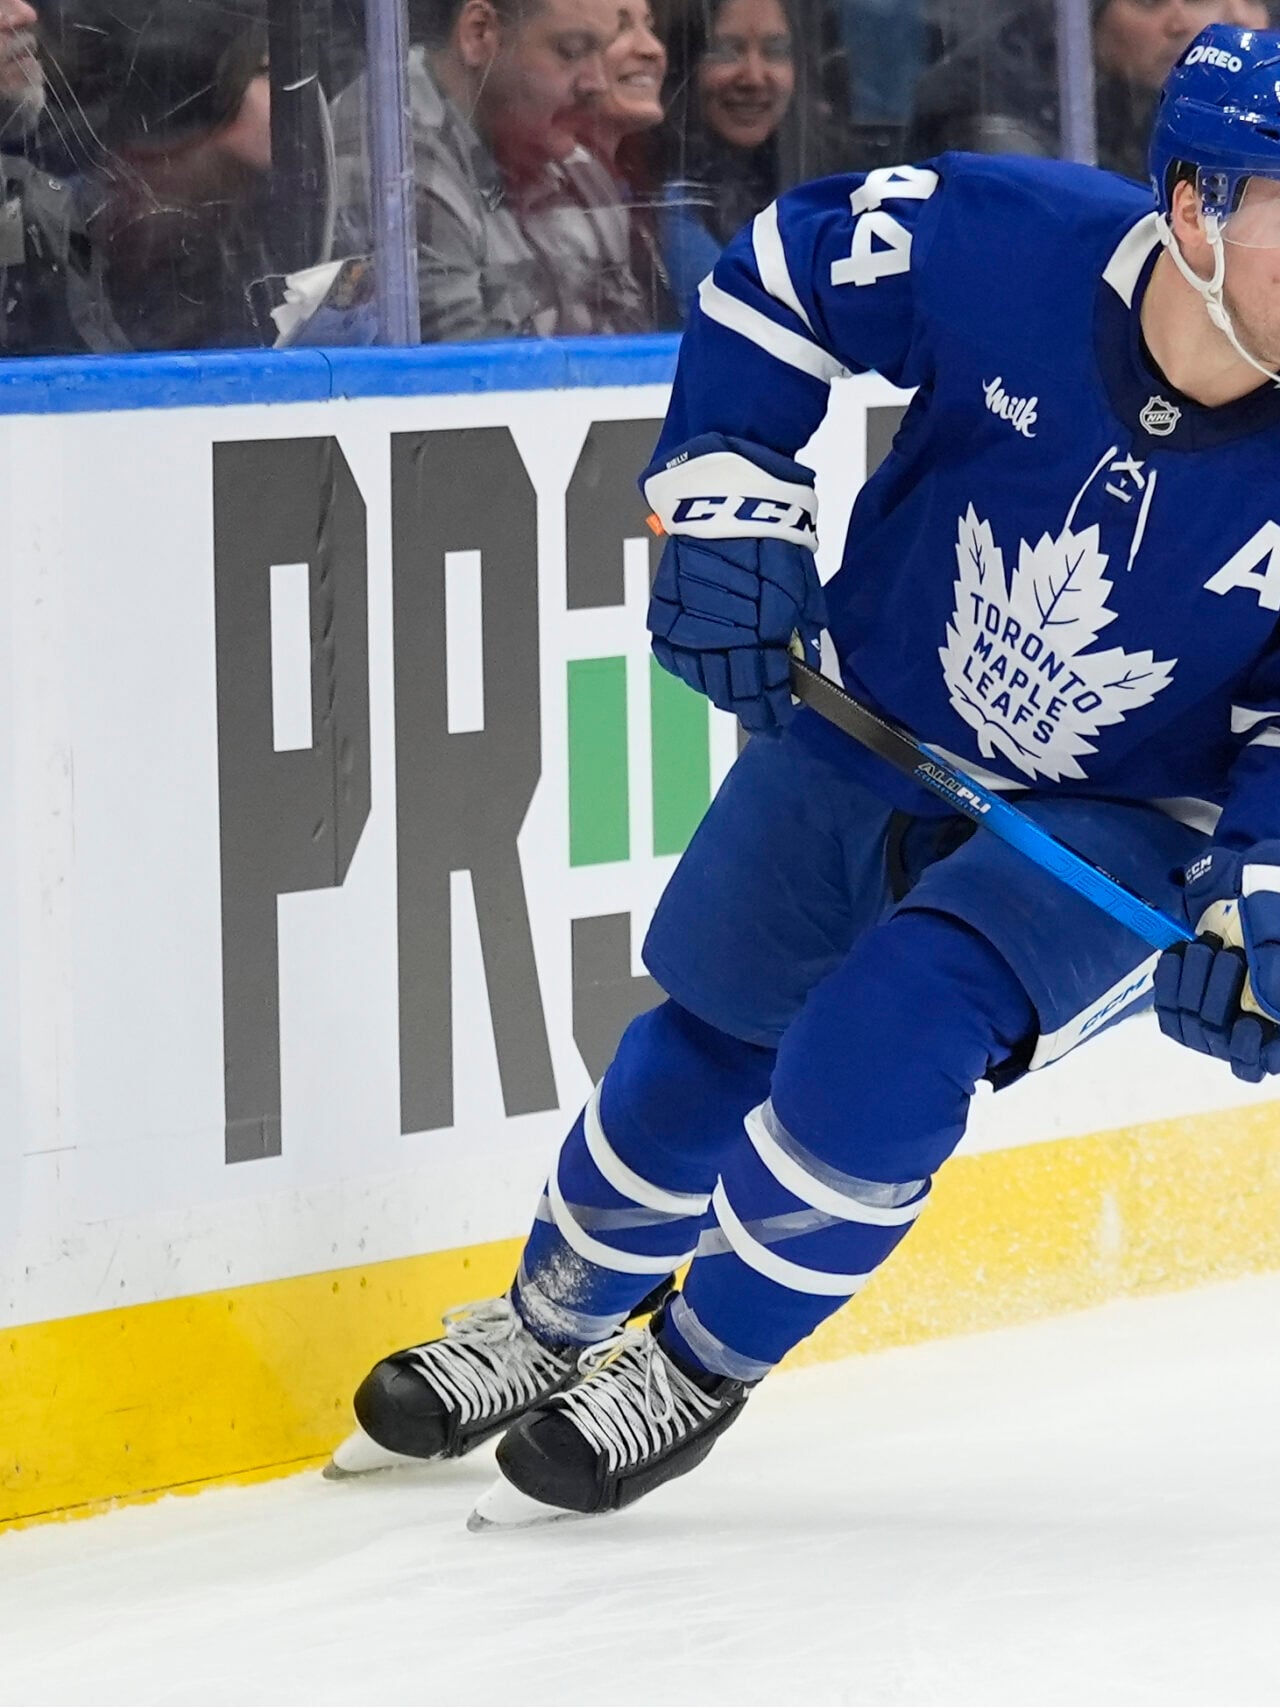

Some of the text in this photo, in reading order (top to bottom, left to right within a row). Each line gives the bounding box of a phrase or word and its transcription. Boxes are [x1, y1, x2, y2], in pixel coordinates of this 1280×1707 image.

[1185, 46, 1242, 73] OREO
[831, 165, 939, 286] 44
[982, 375, 1039, 438] Milk
[970, 592, 1103, 714] TORONTO
[972, 632, 1068, 722] MAPLE
[962, 655, 1055, 744] LEAFS
[213, 405, 920, 1164] PRO
[1185, 854, 1213, 881] CCM
[1079, 972, 1149, 1035] CCM
